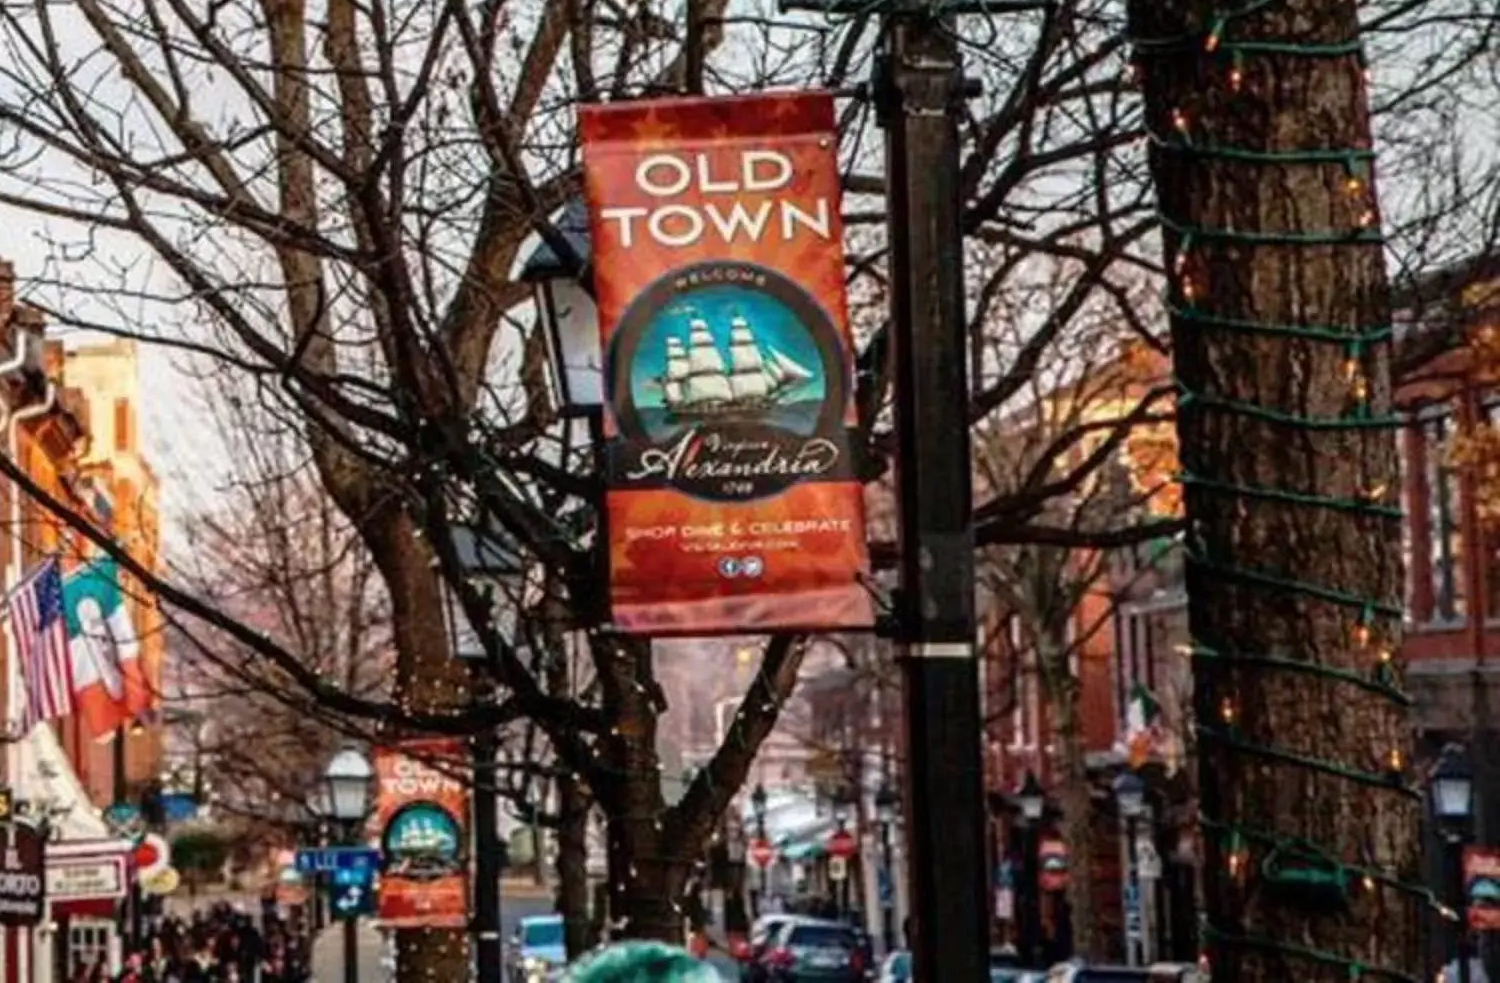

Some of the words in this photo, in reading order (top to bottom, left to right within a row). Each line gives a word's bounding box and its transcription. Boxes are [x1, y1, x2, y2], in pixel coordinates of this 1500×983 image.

[635, 151, 792, 196] OLD
[601, 198, 830, 247] TOWN
[675, 265, 766, 288] WELCOME
[627, 428, 839, 479] Alexandria
[749, 519, 852, 535] CELEBRATE
